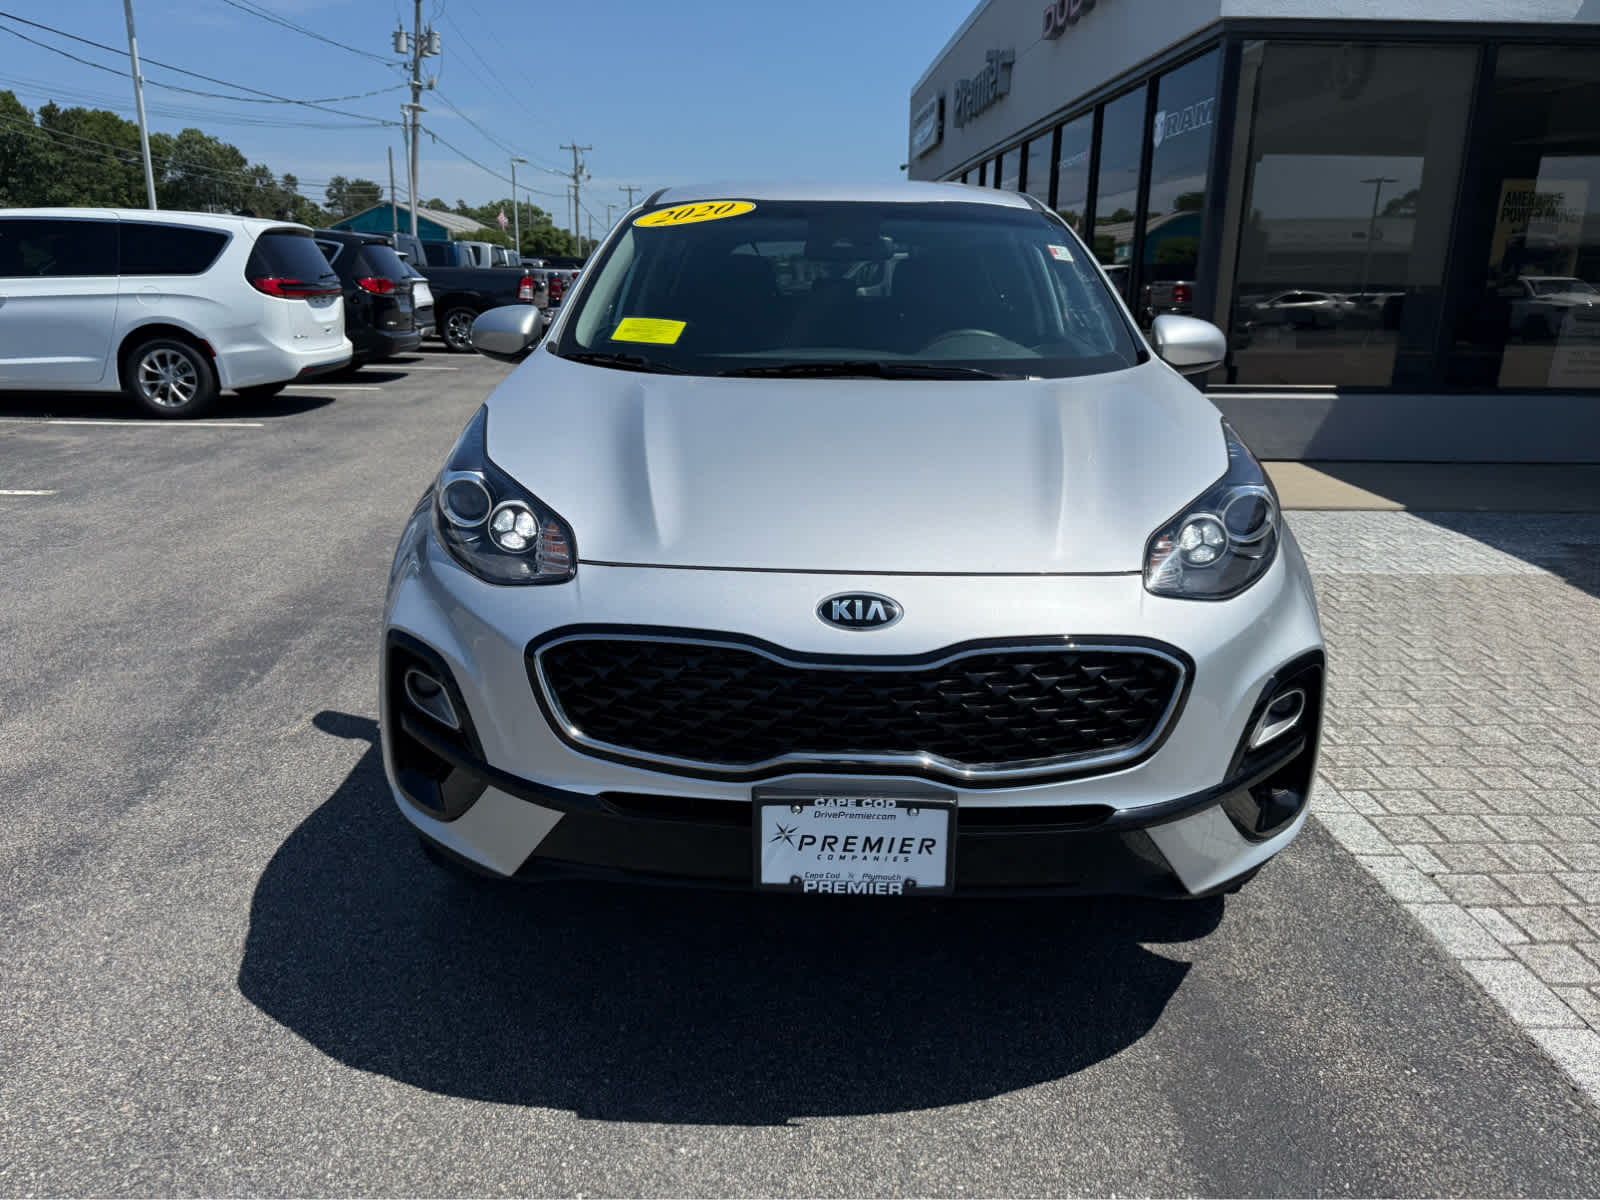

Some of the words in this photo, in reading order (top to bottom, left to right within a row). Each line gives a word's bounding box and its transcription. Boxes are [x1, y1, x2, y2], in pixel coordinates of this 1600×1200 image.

[1165, 97, 1215, 138] RAM
[655, 203, 736, 223] 2020
[832, 600, 887, 620] KIA
[814, 798, 856, 808] CAPE
[862, 799, 897, 809] COD
[814, 811, 896, 820] DrivePremier.com
[798, 835, 936, 855] PREMIER
[817, 854, 910, 863] COMPANIES
[805, 872, 824, 880] Cape
[862, 873, 902, 881] Plymouth
[803, 880, 904, 895] PREMIER
